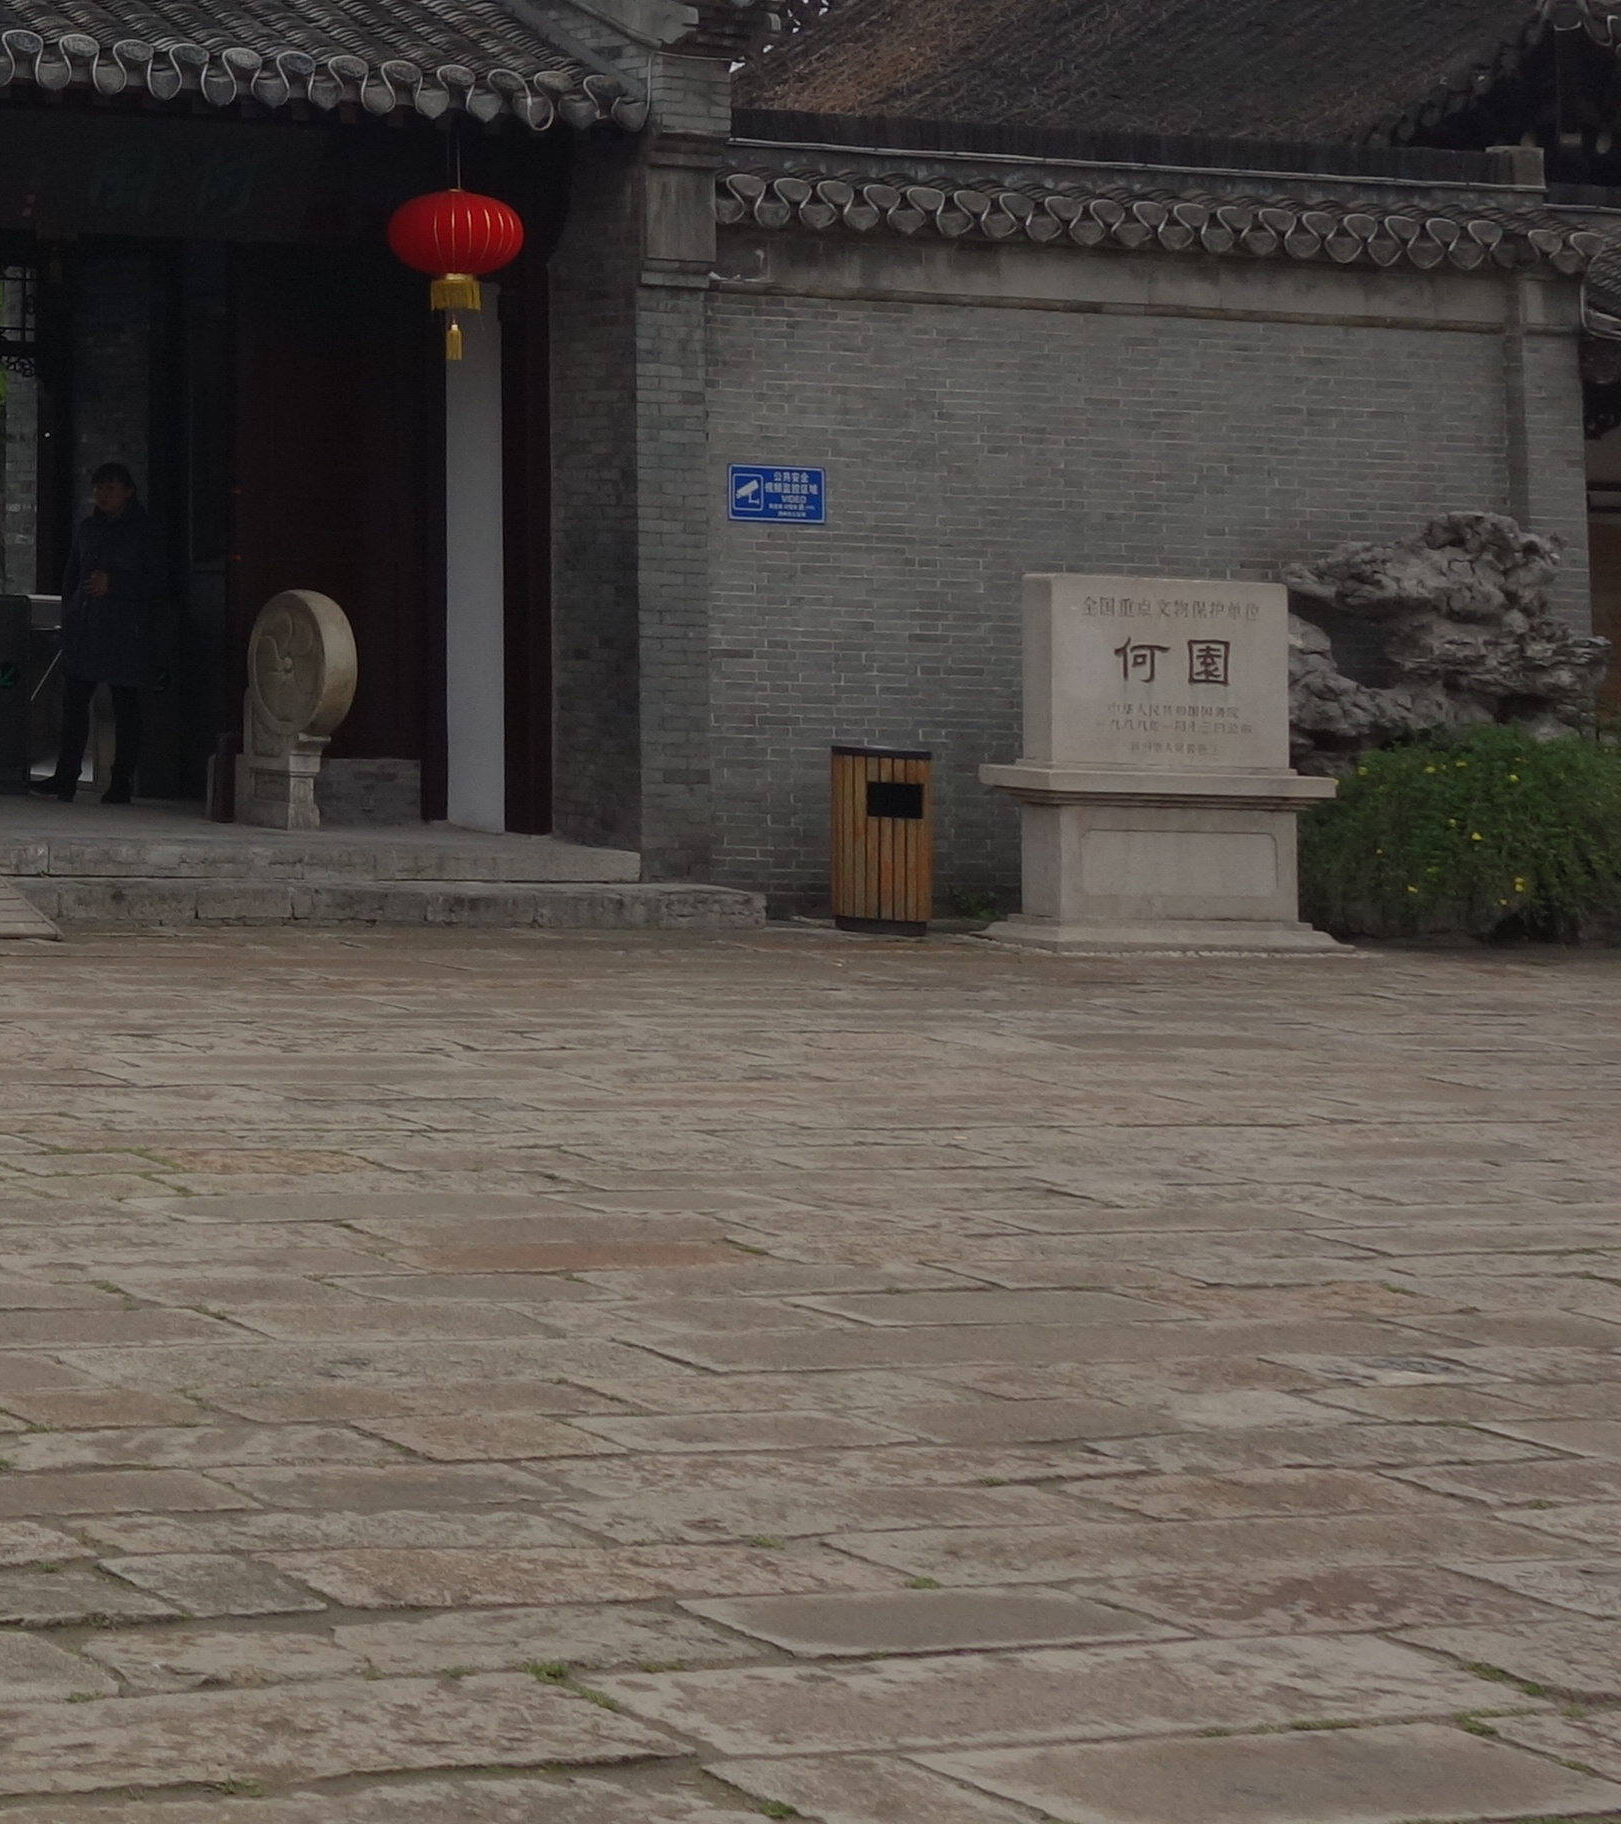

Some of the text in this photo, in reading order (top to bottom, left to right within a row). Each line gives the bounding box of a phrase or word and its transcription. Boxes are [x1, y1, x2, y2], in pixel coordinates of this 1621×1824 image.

[773, 471, 809, 483] 公共安全
[781, 494, 807, 504] VIDEO
[1082, 596, 1260, 621] 全国重点文物保护单位
[1107, 703, 1241, 719] 中华人民共和国国务院
